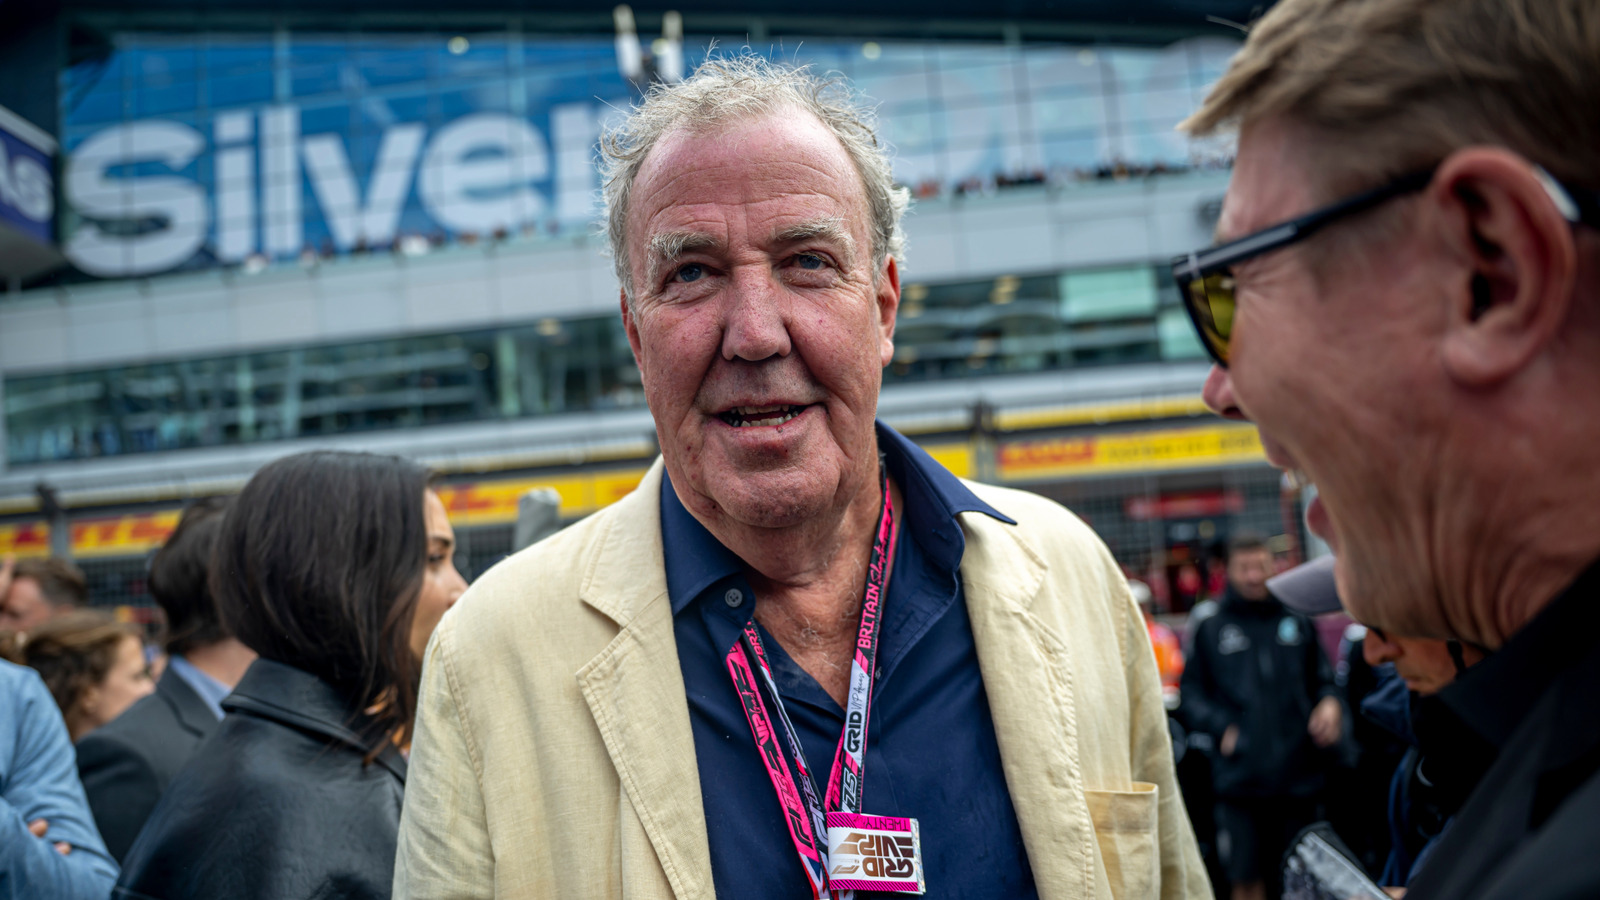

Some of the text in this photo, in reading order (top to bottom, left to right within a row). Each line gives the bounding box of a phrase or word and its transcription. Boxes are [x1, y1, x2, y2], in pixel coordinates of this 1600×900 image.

[857, 583, 880, 649] BRITAIN
[752, 711, 771, 746] VIP
[847, 711, 863, 753] GRID
[862, 857, 914, 878] GRID
